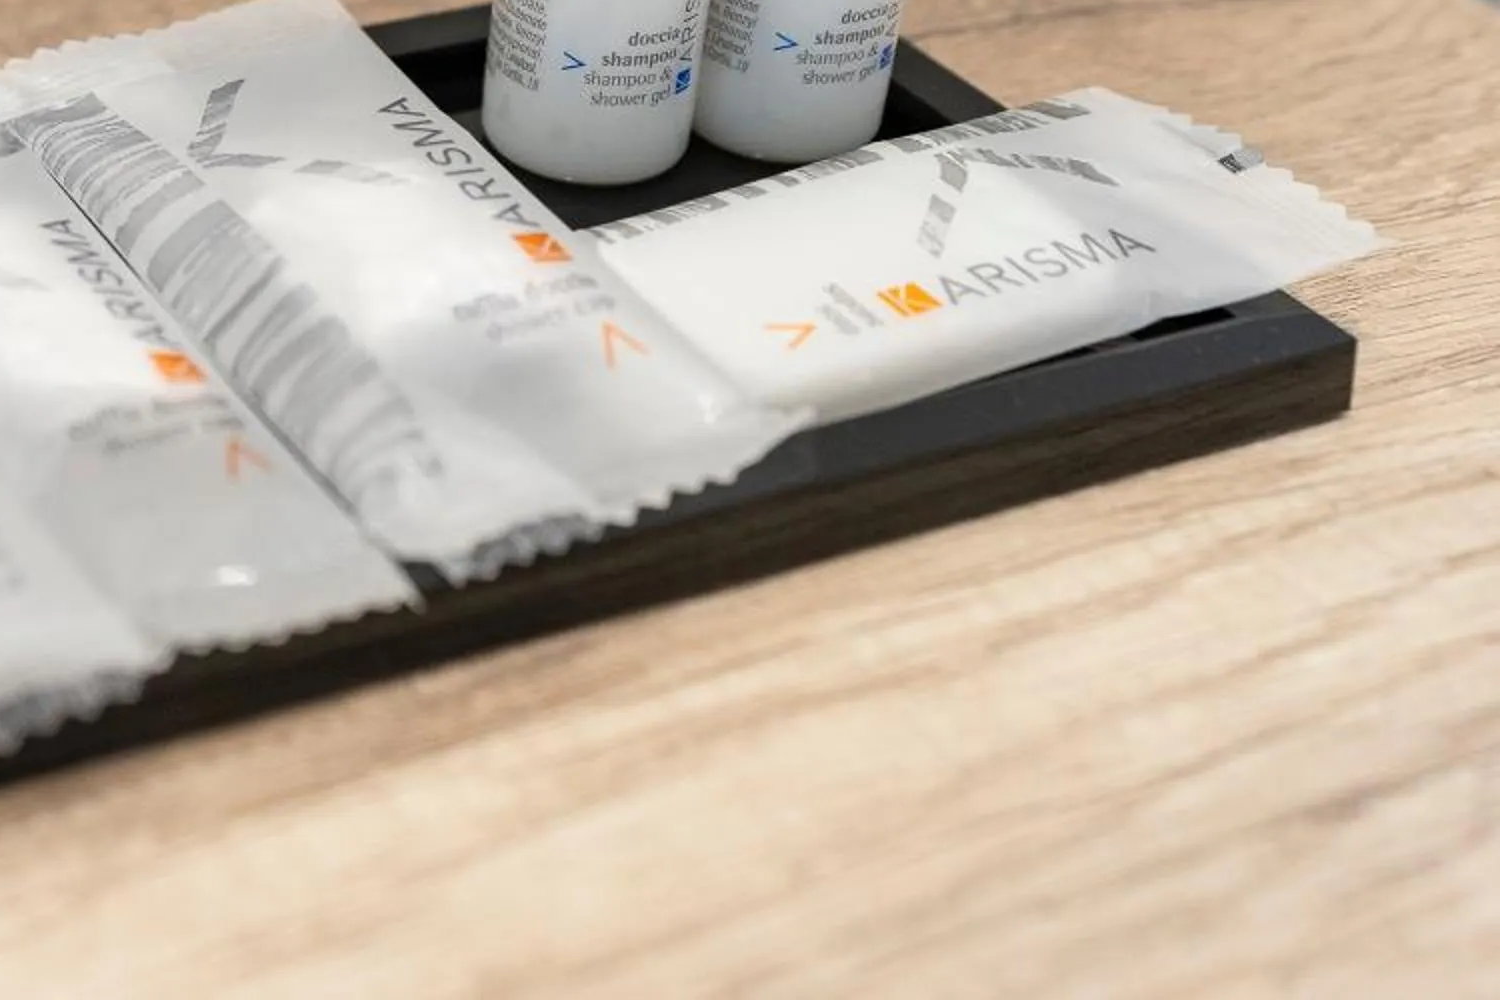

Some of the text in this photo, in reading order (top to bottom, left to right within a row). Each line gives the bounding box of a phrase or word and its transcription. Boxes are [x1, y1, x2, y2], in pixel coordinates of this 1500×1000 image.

[628, 26, 681, 47] doccia
[813, 24, 885, 45] shampoo
[602, 47, 677, 68] shampoo
[796, 48, 864, 68] shampoo
[583, 70, 657, 88] shampoo
[803, 68, 855, 86] shower
[591, 91, 647, 107] shower
